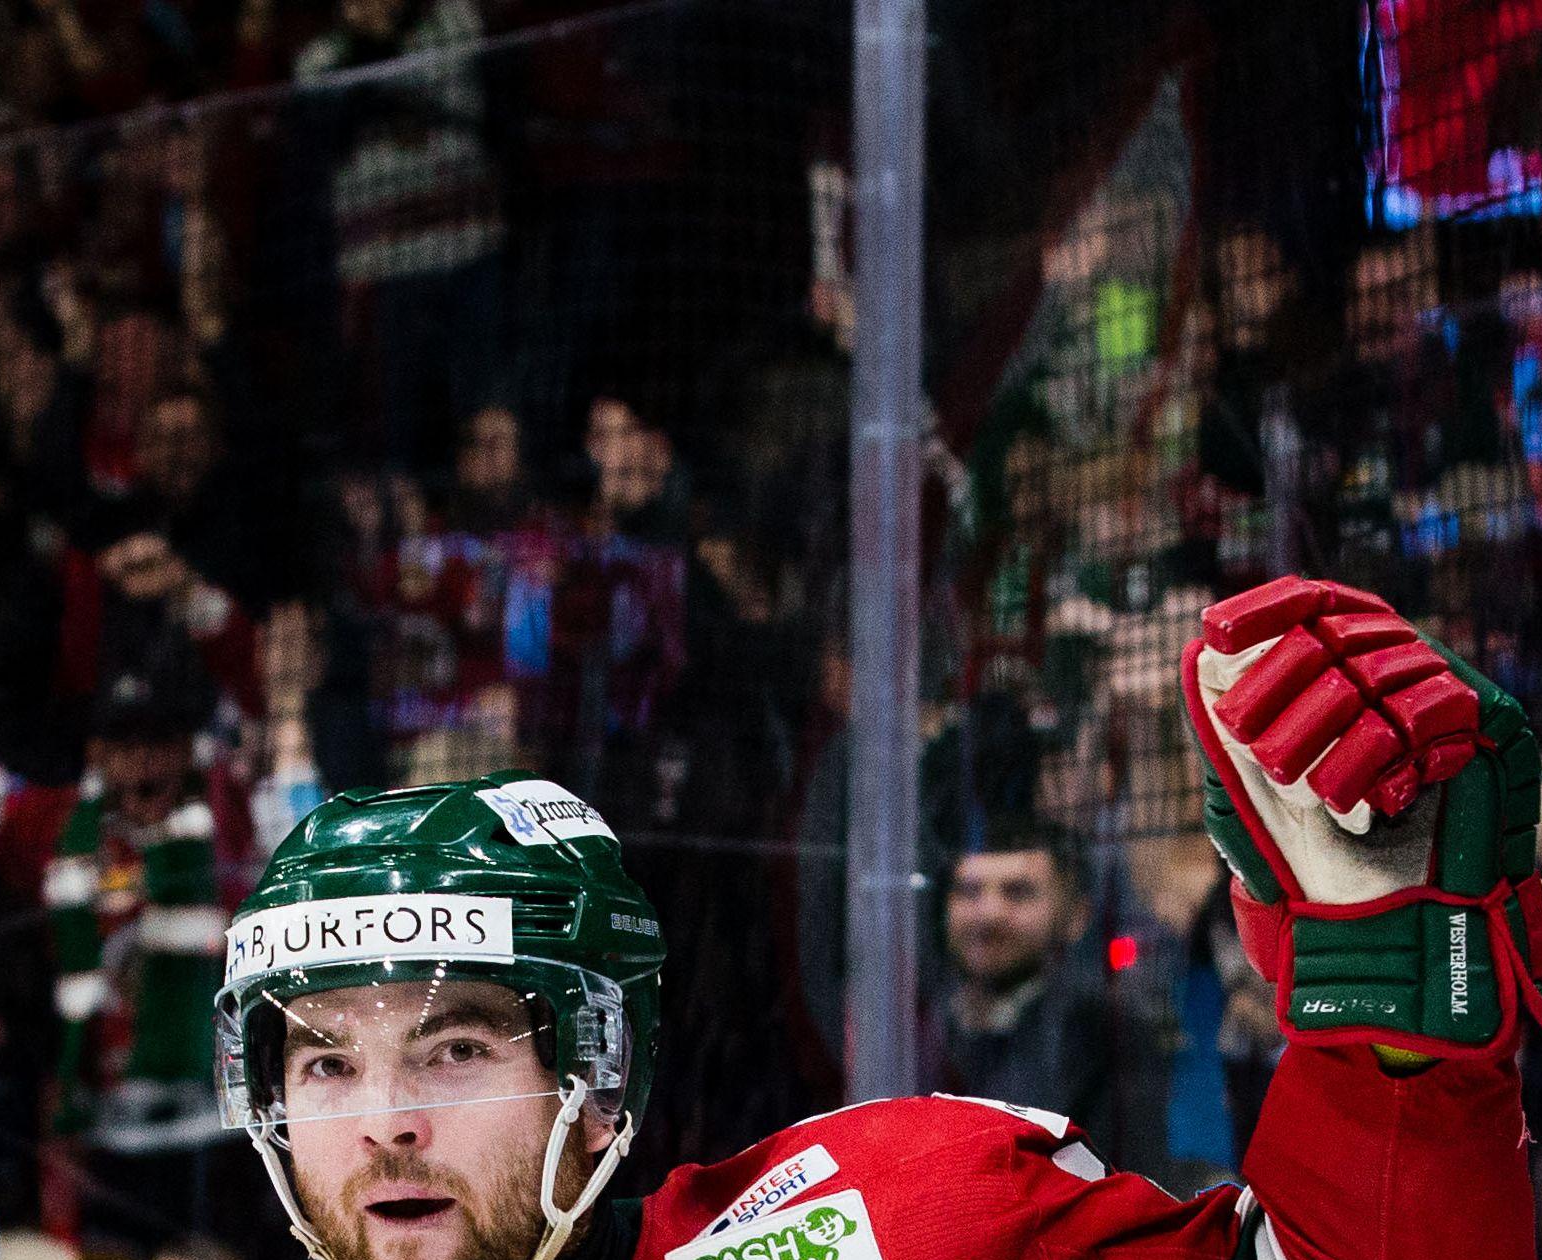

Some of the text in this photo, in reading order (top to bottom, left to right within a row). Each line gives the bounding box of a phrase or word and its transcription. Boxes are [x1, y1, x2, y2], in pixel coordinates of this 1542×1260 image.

[1448, 911, 1469, 1017] WESTERHOLM
[731, 1160, 804, 1218] INTER
[737, 1170, 809, 1225] SPORT
